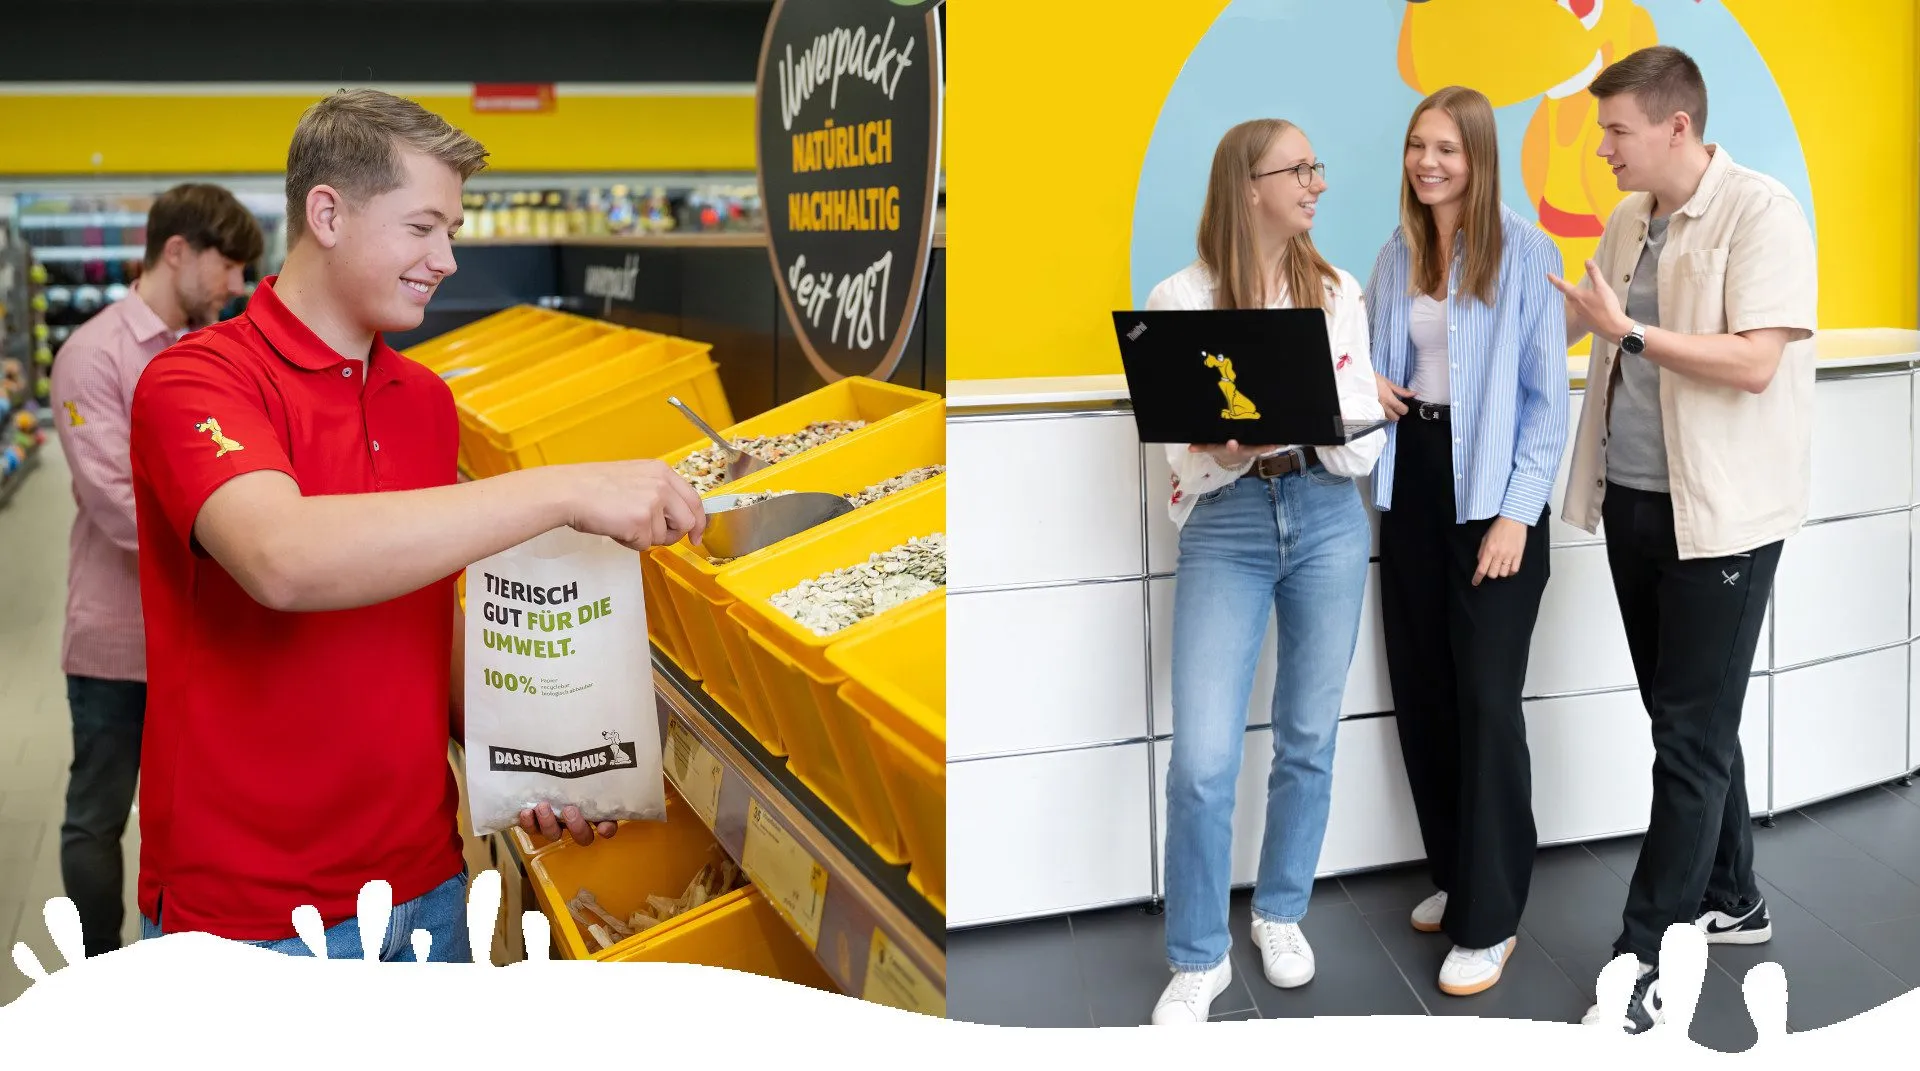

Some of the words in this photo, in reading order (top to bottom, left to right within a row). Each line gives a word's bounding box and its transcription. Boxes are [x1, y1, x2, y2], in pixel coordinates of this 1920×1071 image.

[778, 16, 915, 131] Unverpackt
[791, 118, 892, 173] NATÜRLICH
[788, 186, 900, 232] NACHHALTIG
[831, 251, 893, 350] 1987
[484, 572, 578, 605] TIERISCH
[483, 601, 522, 628] GUT
[527, 609, 574, 633] FÜR
[577, 596, 612, 625] DIE
[483, 628, 576, 659] UMWELT.
[483, 668, 537, 695] 100%
[494, 751, 521, 766] DAS
[523, 752, 607, 774] FUTTERHAUS
